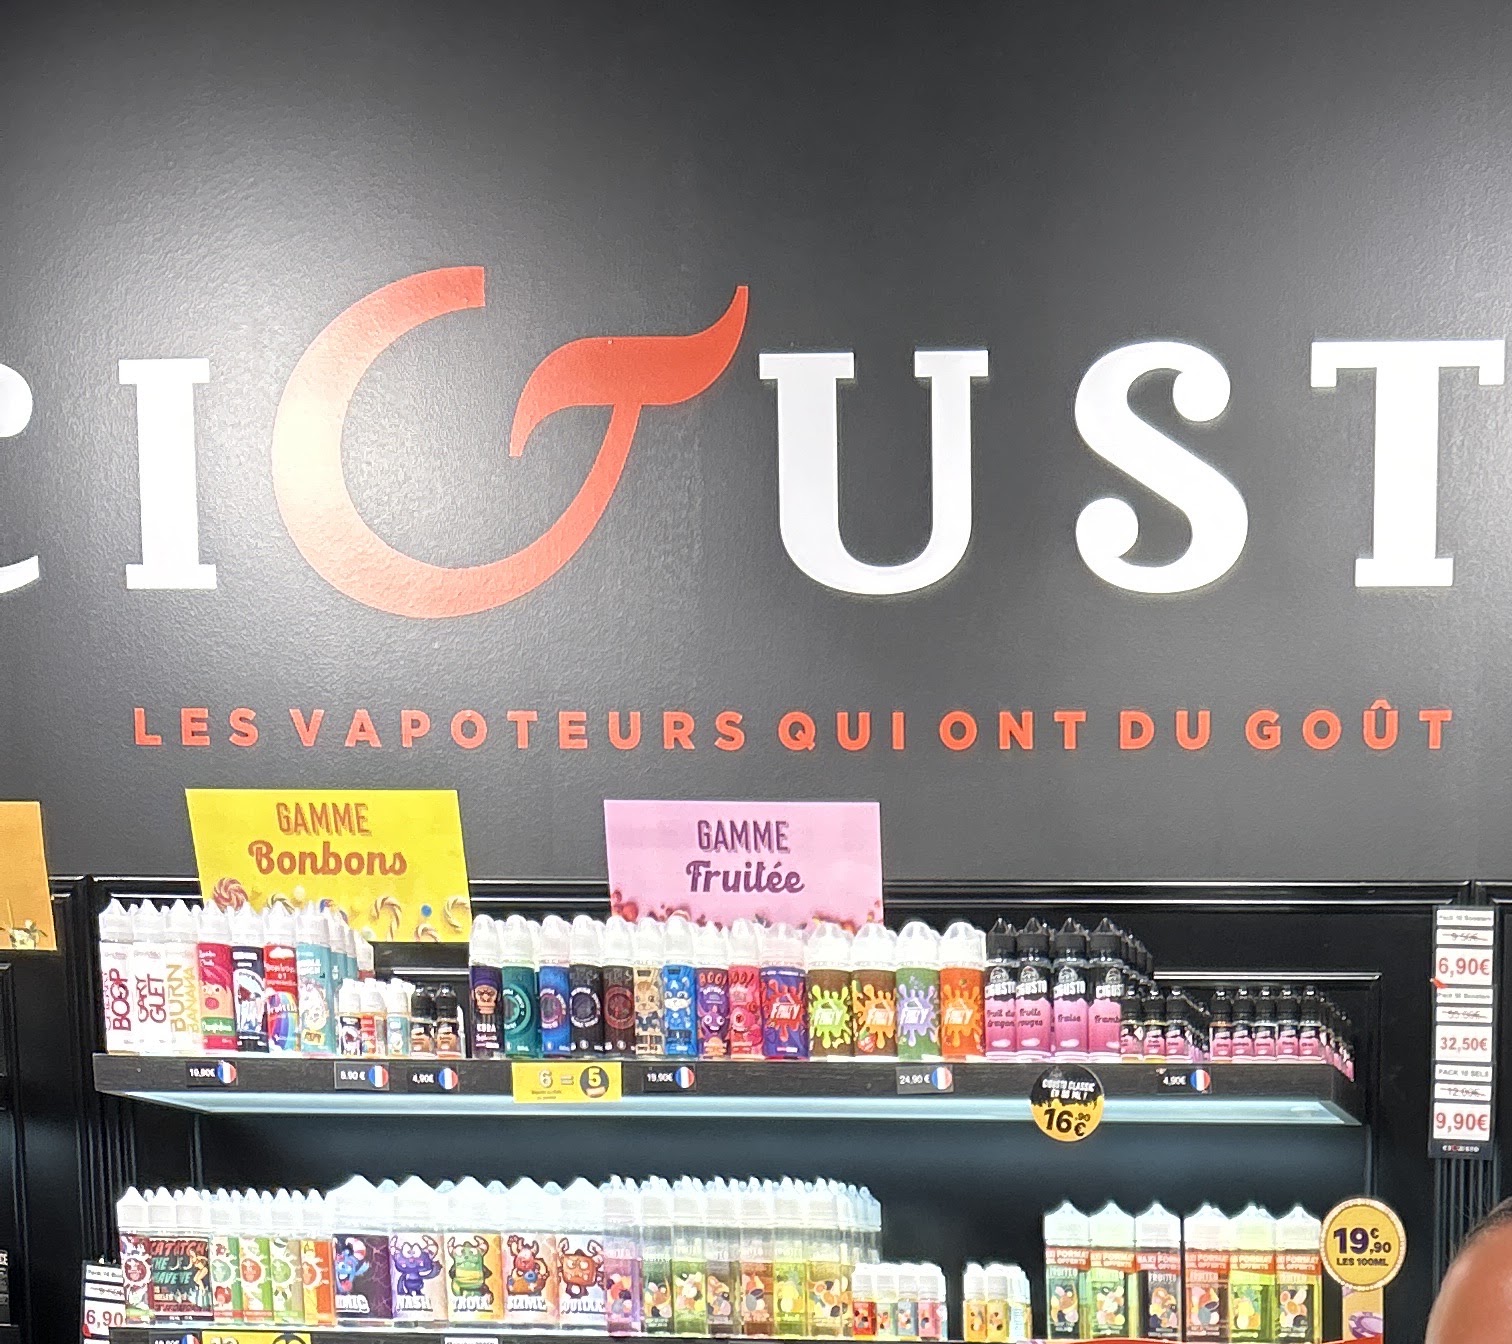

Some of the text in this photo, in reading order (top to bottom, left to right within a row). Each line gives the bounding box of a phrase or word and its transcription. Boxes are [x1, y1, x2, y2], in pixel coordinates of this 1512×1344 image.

[134, 699, 1454, 753] LES VAPOTEURS QUI ONT DU GOÛT
[276, 802, 372, 837] GAMME
[697, 819, 791, 854] GAMME
[248, 840, 408, 877] Bonbons
[686, 860, 806, 894] Fruitée
[1438, 956, 1491, 978] 6,90€
[166, 964, 187, 1032] BURN
[1440, 1037, 1488, 1053] 32,50€
[539, 1069, 553, 1088] 6
[587, 1067, 602, 1086] 5
[1043, 1108, 1074, 1134] 16
[1435, 1112, 1489, 1134] 9,90€
[1333, 1227, 1370, 1255] 19
[1336, 1258, 1355, 1266] LES
[86, 1308, 125, 1329] 6,90
